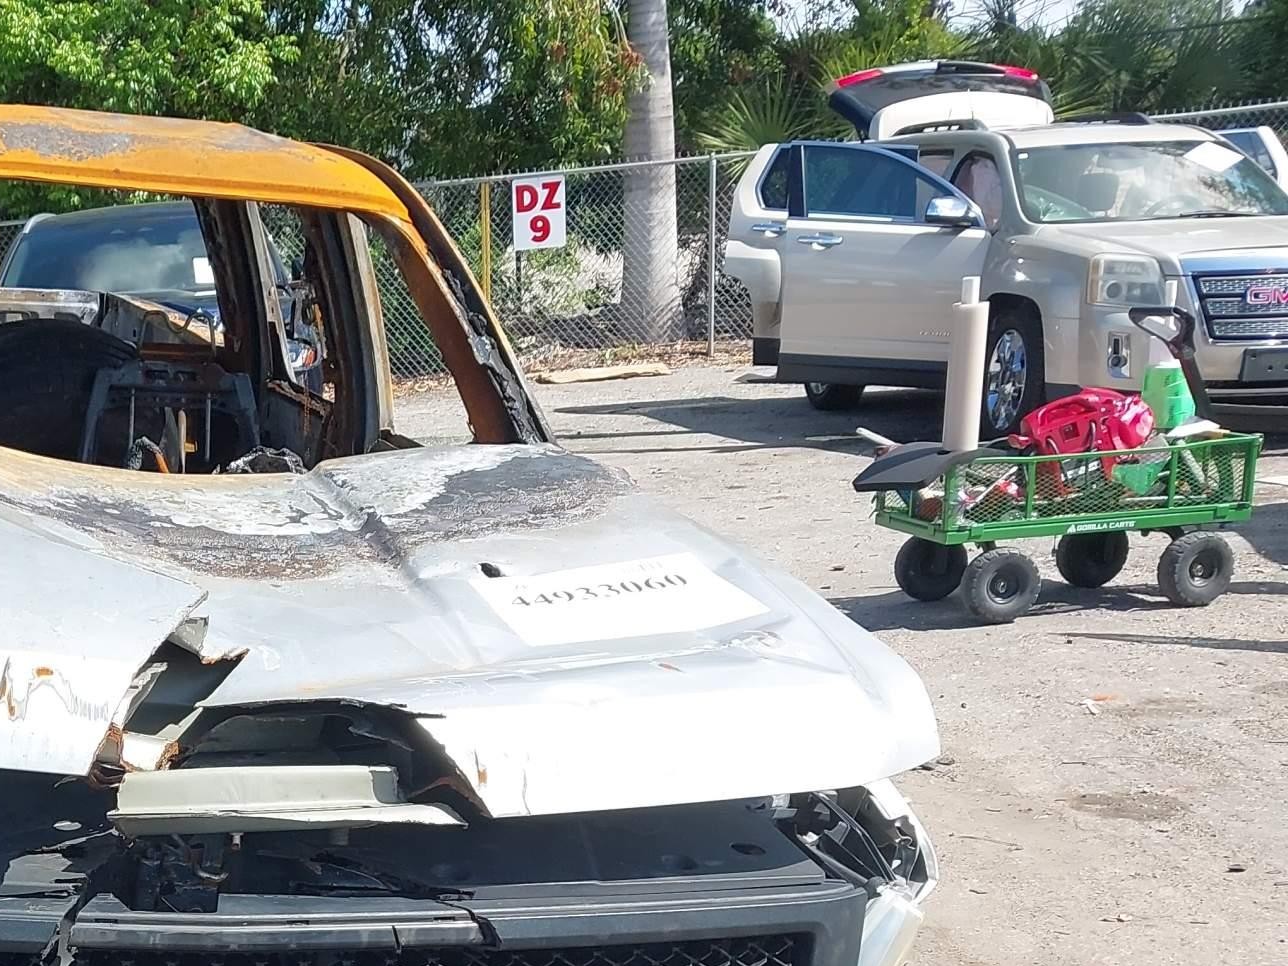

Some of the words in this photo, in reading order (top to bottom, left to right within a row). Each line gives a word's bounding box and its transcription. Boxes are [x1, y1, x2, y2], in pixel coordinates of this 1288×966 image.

[515, 180, 562, 213] DZ
[529, 214, 551, 243] 9
[1076, 522, 1107, 532] GORILLA
[1109, 520, 1135, 529] CARTS
[511, 574, 688, 606] 44933060
